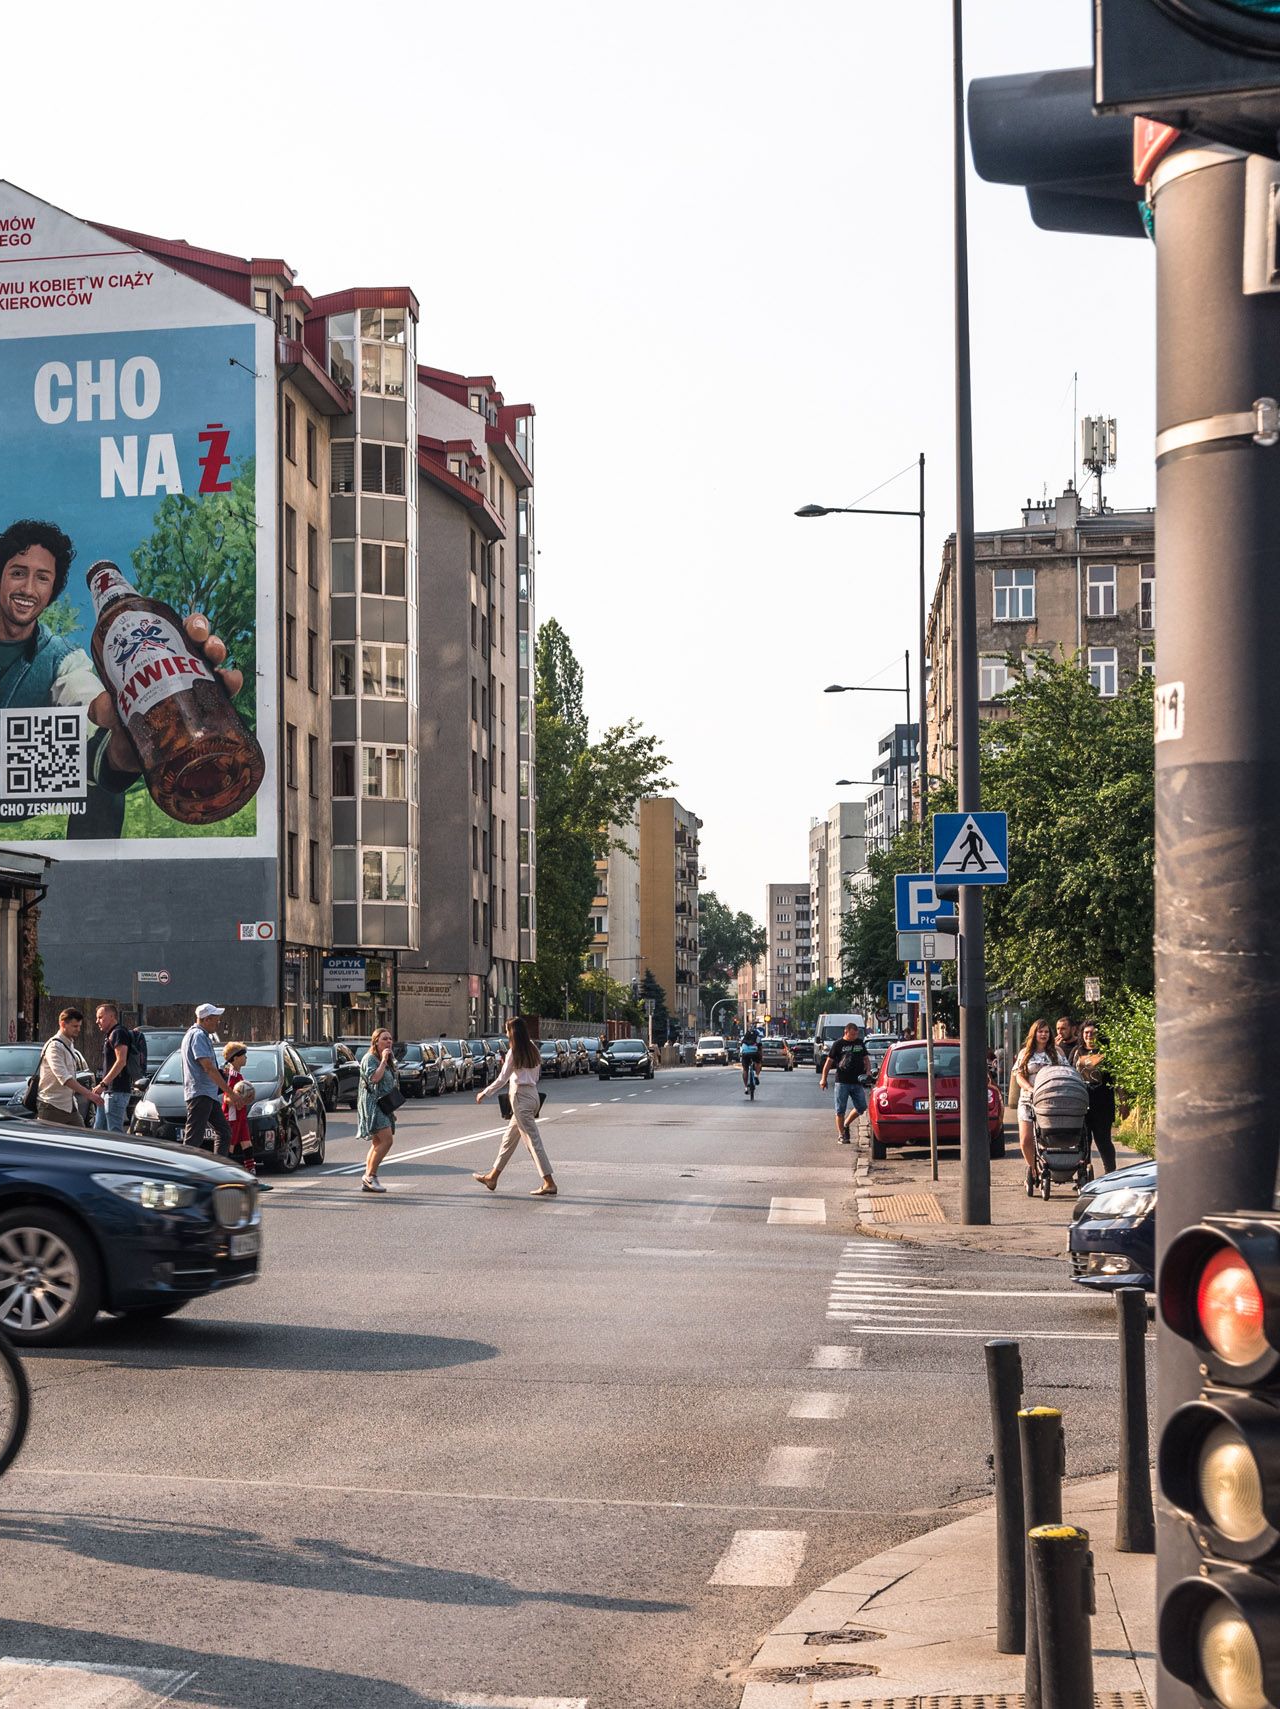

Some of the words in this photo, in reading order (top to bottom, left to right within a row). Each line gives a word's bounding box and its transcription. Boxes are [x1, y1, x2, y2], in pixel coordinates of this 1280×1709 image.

[29, 277, 86, 294] KOBIET
[89, 276, 105, 289] W
[107, 270, 154, 290] CIĄŻY
[34, 355, 161, 425] CHO
[100, 433, 184, 499] NA
[0, 803, 25, 817] CHO
[26, 801, 87, 817] ZESKANUJ
[908, 881, 941, 925] P
[328, 960, 361, 968] OPTYK
[909, 977, 942, 987] Koec
